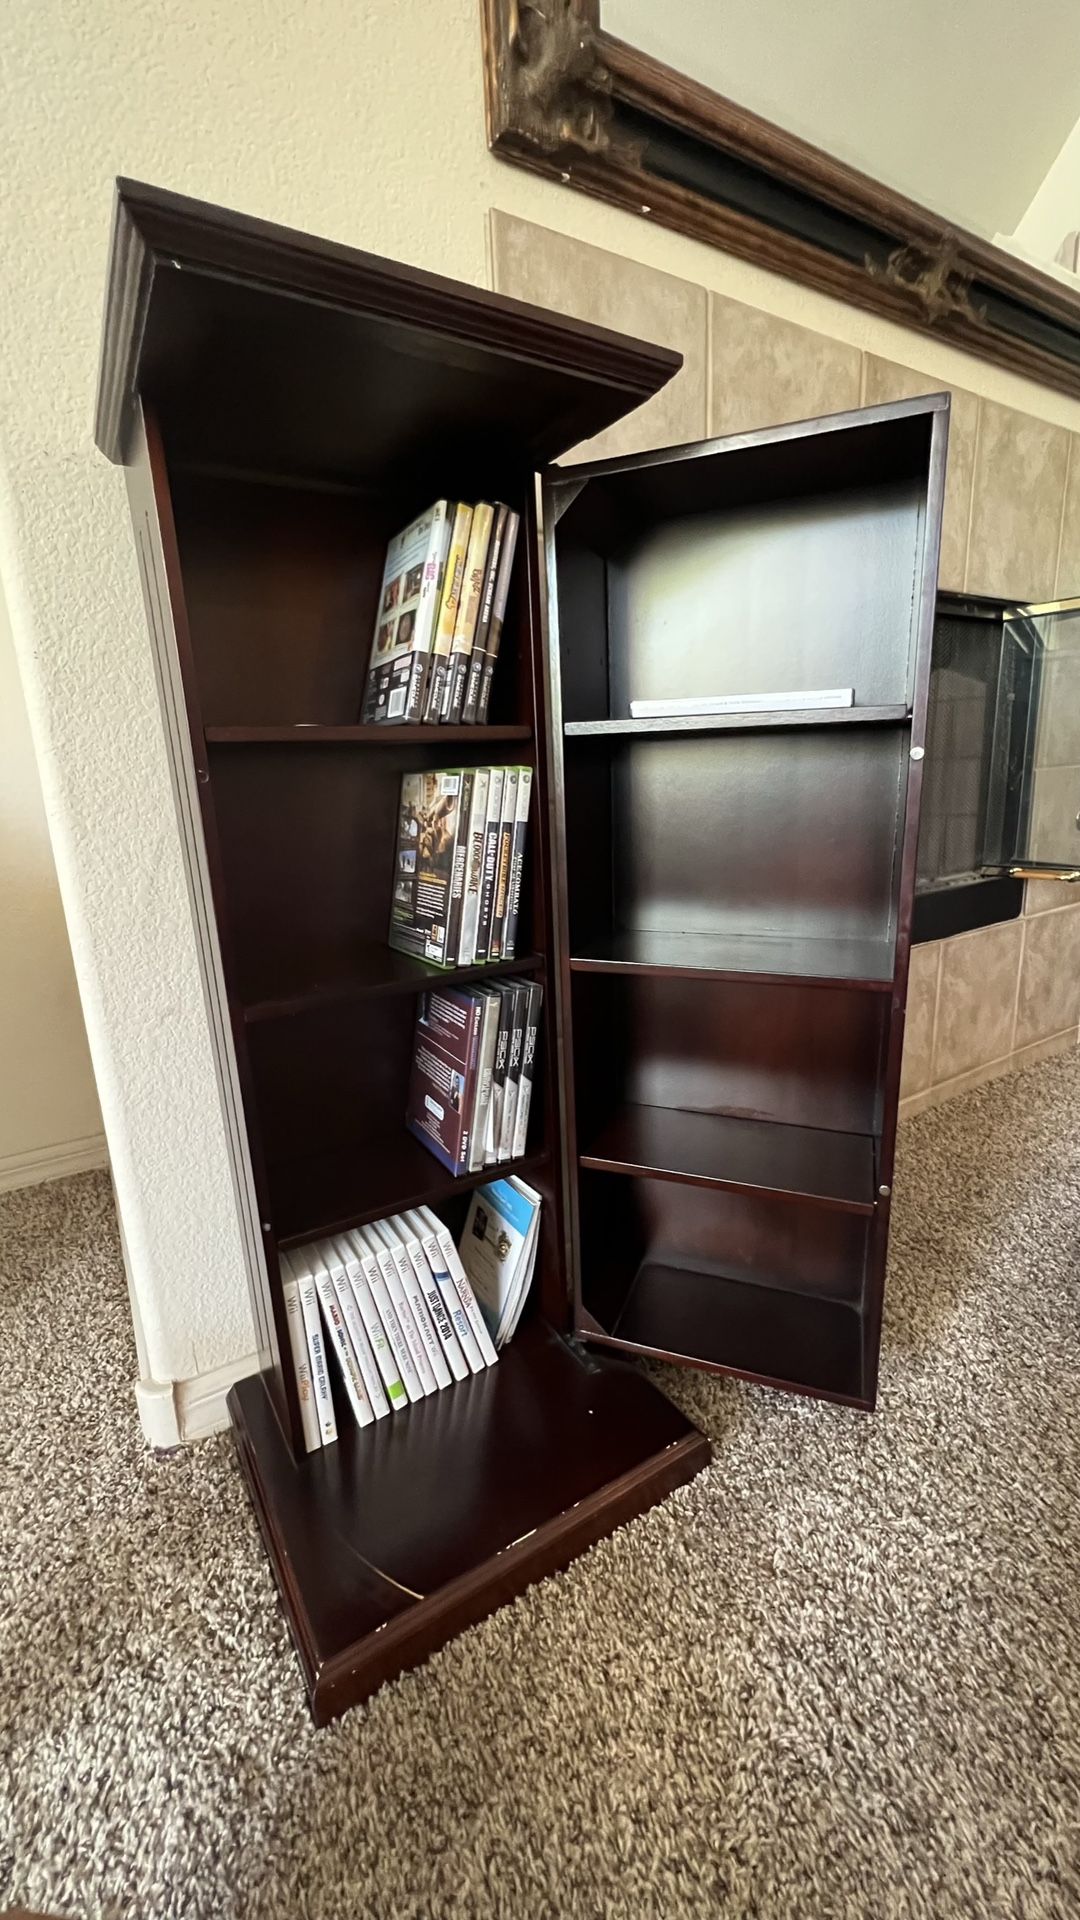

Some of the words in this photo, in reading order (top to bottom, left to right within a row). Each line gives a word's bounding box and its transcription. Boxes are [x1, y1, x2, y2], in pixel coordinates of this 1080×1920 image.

[473, 832, 484, 860] BLOOD
[487, 832, 497, 854] CALL
[452, 845, 466, 899] MERCENARIES
[485, 856, 495, 881] DUTY
[513, 870, 522, 908] COMBAT
[428, 1241, 439, 1258] Wii
[443, 1241, 454, 1257] Wii
[383, 1260, 395, 1277] Wii
[398, 1257, 410, 1273] Wii
[413, 1251, 425, 1268] Wii
[336, 1274, 348, 1292] Wii
[353, 1271, 365, 1289] Wii
[368, 1266, 380, 1284] Wii
[304, 1287, 315, 1306] Wii
[321, 1281, 334, 1299] Wii
[427, 1290, 440, 1305] JUST
[287, 1295, 298, 1314] Wii
[432, 1303, 446, 1324] DANCE
[440, 1322, 453, 1340] 2014
[453, 1310, 468, 1337] Resort
